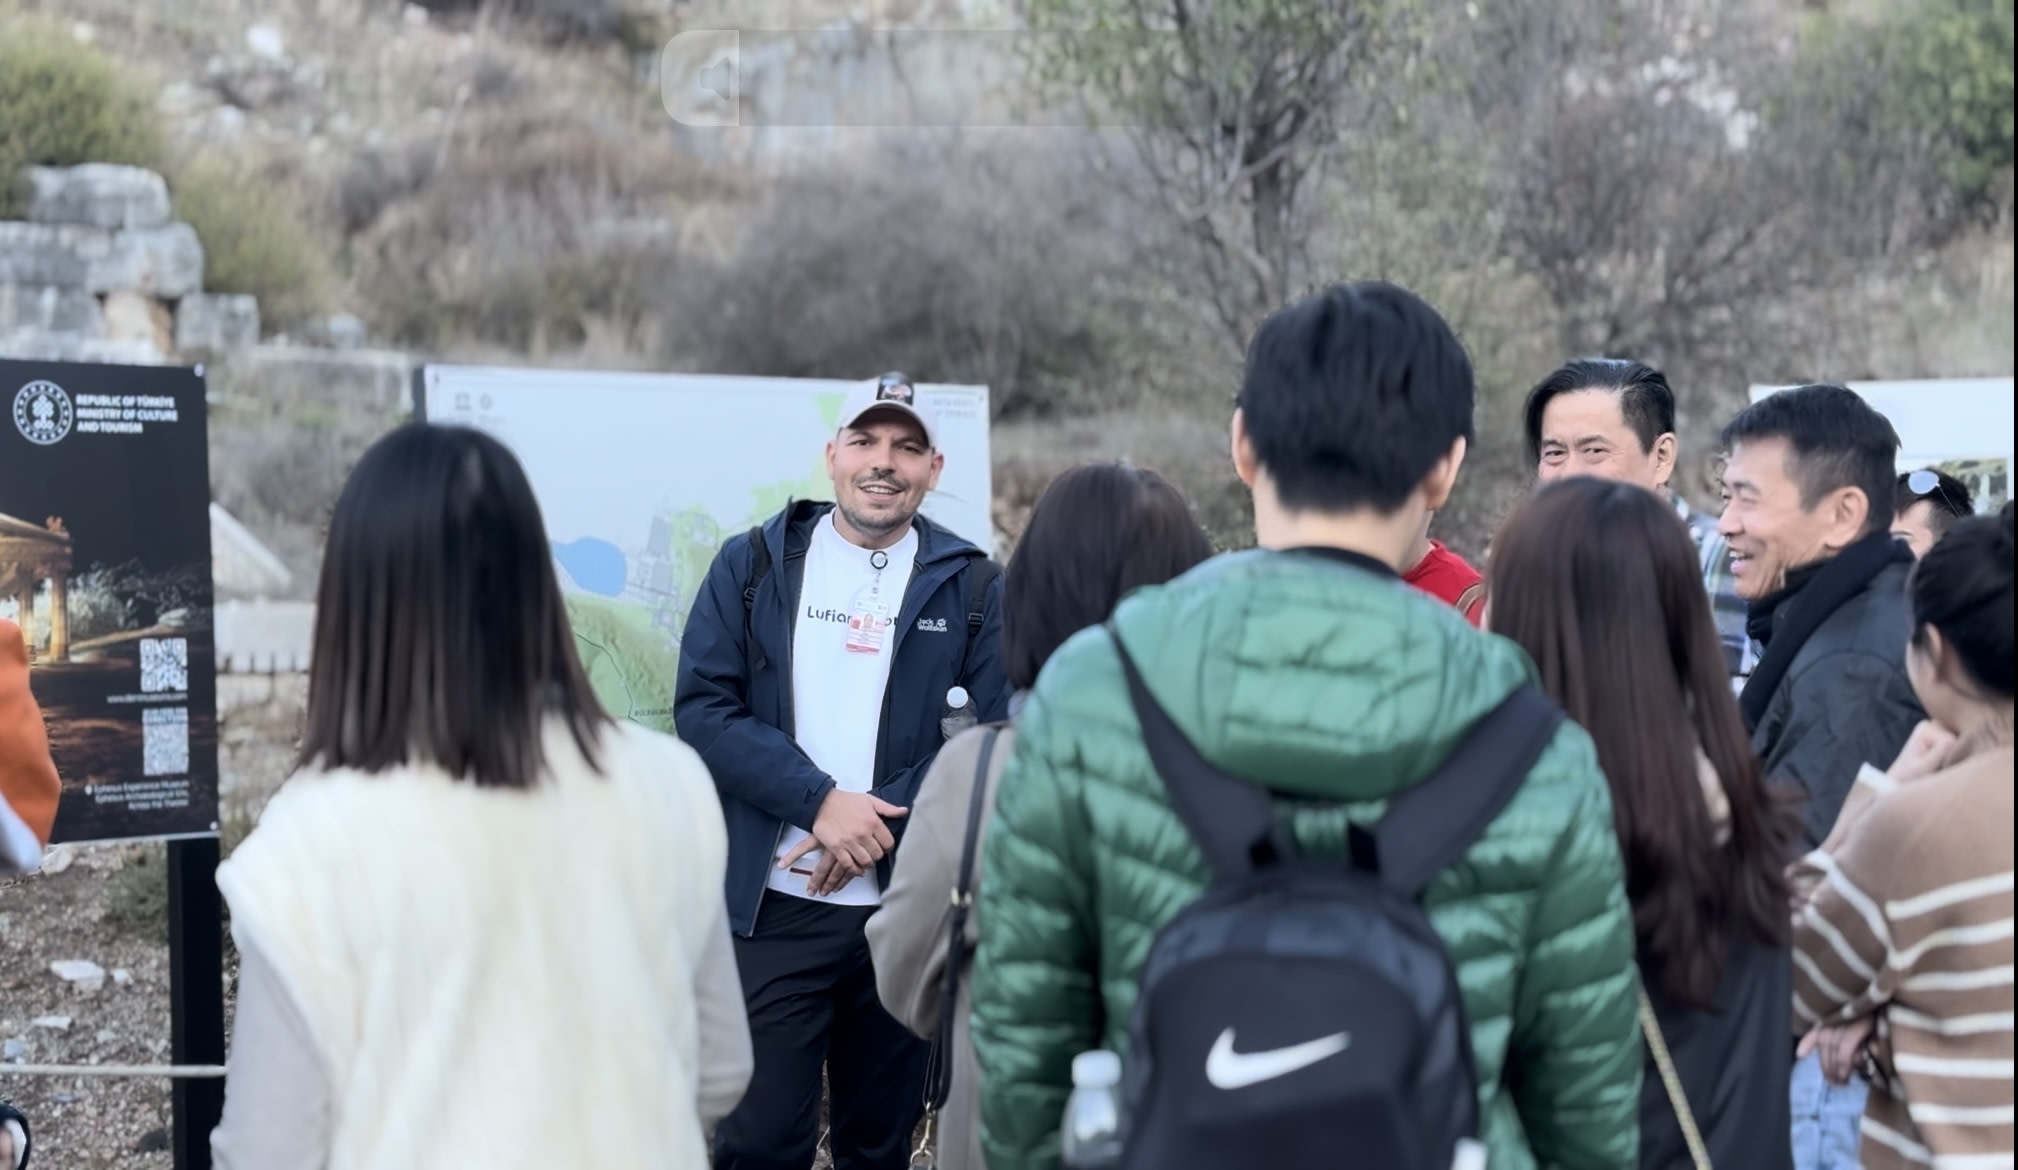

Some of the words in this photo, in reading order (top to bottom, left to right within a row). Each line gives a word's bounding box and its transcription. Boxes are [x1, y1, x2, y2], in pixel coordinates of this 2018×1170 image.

[76, 394, 121, 406] REPUBLIC
[122, 395, 136, 407] OF
[76, 408, 121, 419] MINISTRY
[123, 409, 136, 421] OF
[137, 409, 178, 421] CULTURE
[77, 421, 99, 433] AND
[100, 422, 143, 433] TOURISM
[917, 618, 933, 626] Jack
[917, 623, 948, 633] Wolfskin
